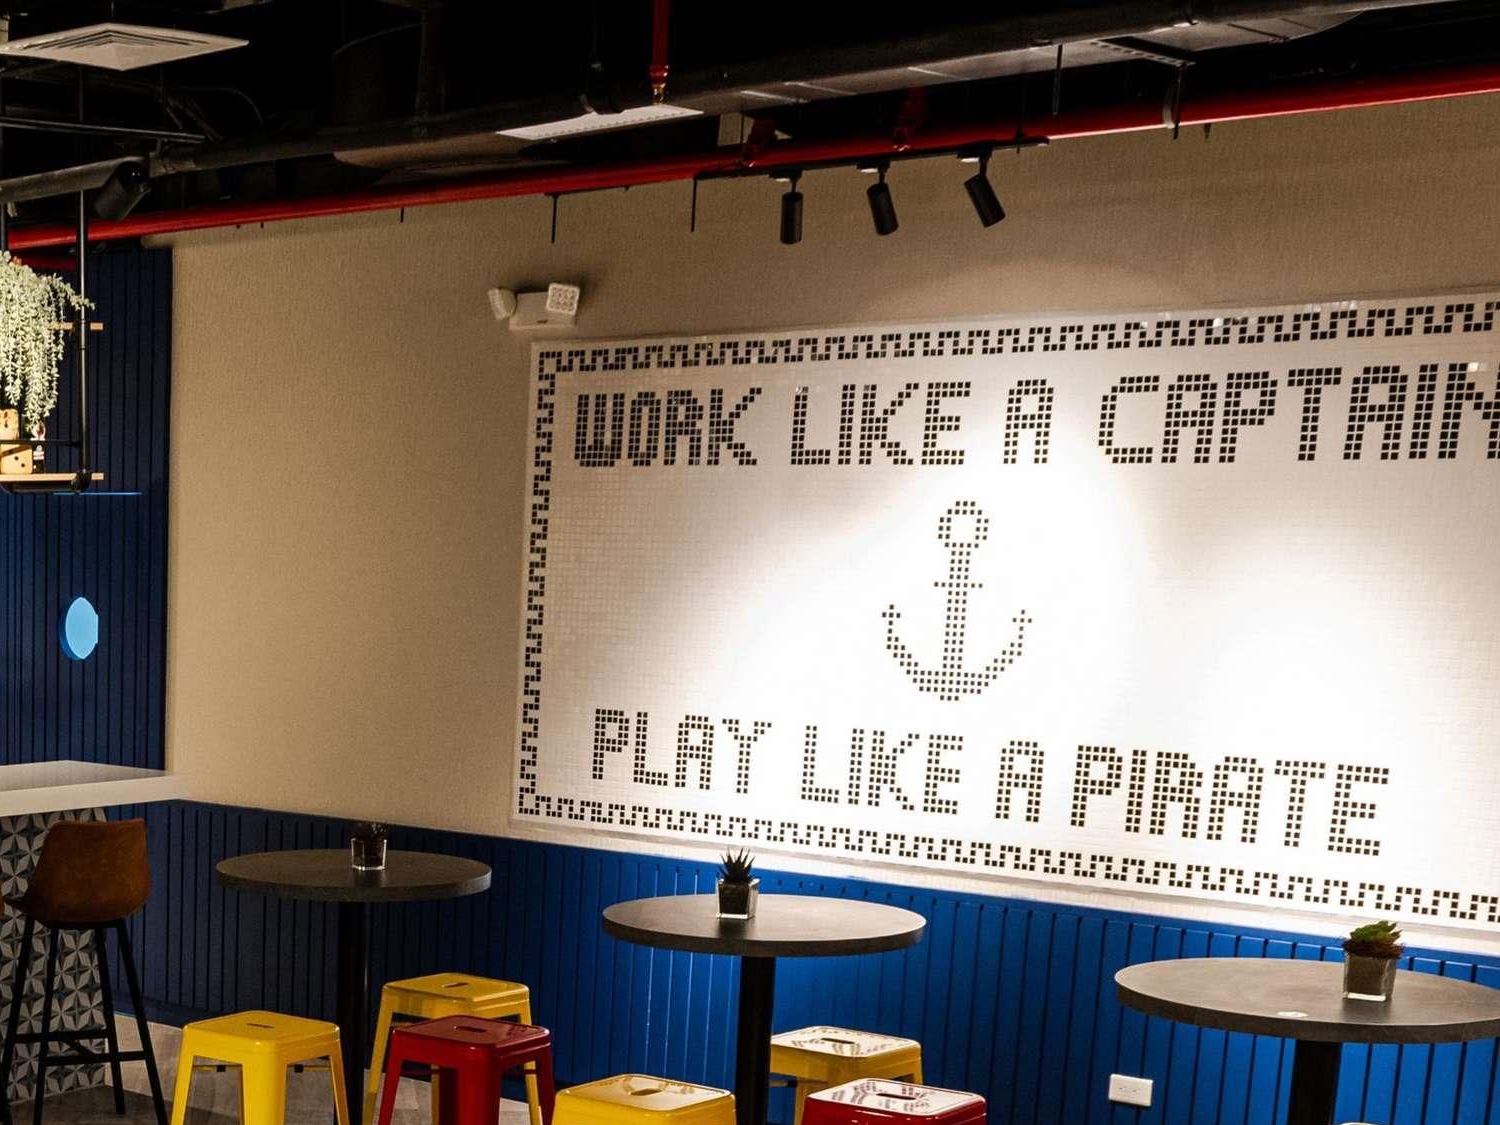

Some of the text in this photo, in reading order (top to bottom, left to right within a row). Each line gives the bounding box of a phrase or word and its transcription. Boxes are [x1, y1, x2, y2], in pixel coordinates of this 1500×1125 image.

[573, 363, 1500, 467] WORK LIKE A CAPTAIN
[591, 707, 1390, 858] PLAY LIKE A PIRATE
